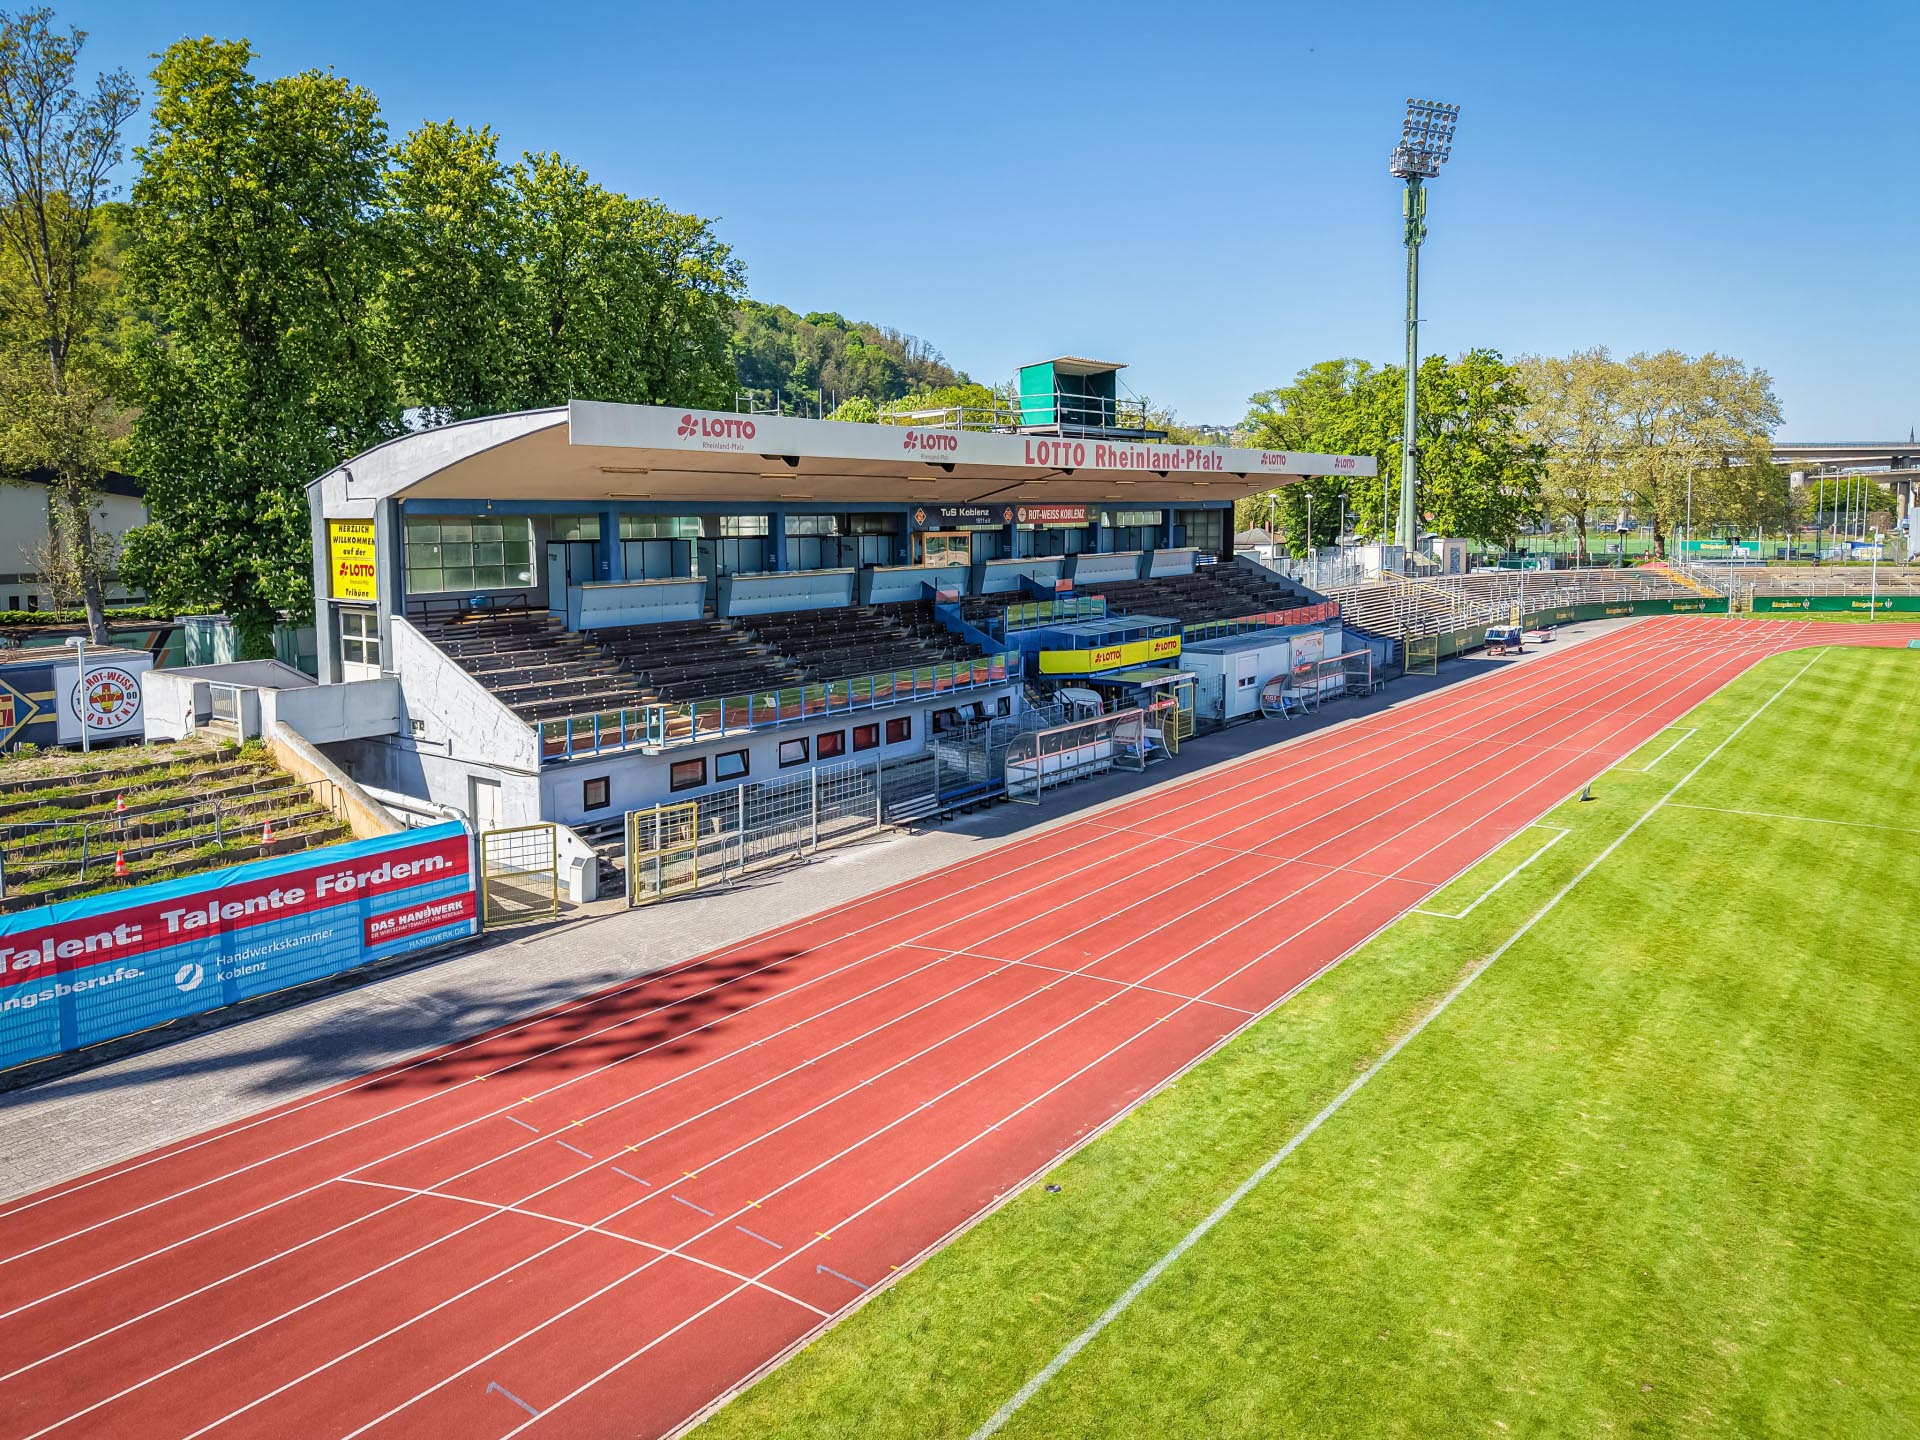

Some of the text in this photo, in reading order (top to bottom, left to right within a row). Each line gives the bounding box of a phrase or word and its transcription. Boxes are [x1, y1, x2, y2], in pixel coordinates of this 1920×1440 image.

[702, 418, 756, 439] LOTTO
[702, 442, 744, 450] Rheinland-Pfalz
[920, 434, 957, 451] LOTTO
[1025, 440, 1223, 471] LOTTO Rheinland-Pfalz
[1268, 454, 1286, 466] LOTTO
[1340, 458, 1355, 469] LOTTO
[941, 508, 989, 517] TuS Koblenz
[1028, 510, 1059, 520] ROT-WEISS
[1060, 508, 1085, 519] KOBLENZ
[338, 525, 369, 533] HERZLICH
[343, 547, 366, 556] auf der
[350, 564, 375, 577] LOTTO
[345, 588, 369, 597] Tribüne
[1161, 641, 1177, 651] LOTTO
[1103, 651, 1121, 662] LOTTO
[86, 671, 134, 691] ROT-WEISS
[126, 691, 138, 700] 00
[160, 887, 305, 934] Talente
[316, 855, 453, 898] Fördern.
[371, 900, 464, 933] DAS HANDWERK
[408, 927, 466, 949] HANDWERK.DE
[216, 928, 334, 967] Handwerkskammer
[217, 961, 267, 982] Koblenz
[0, 967, 145, 1012] ngsberufe.
